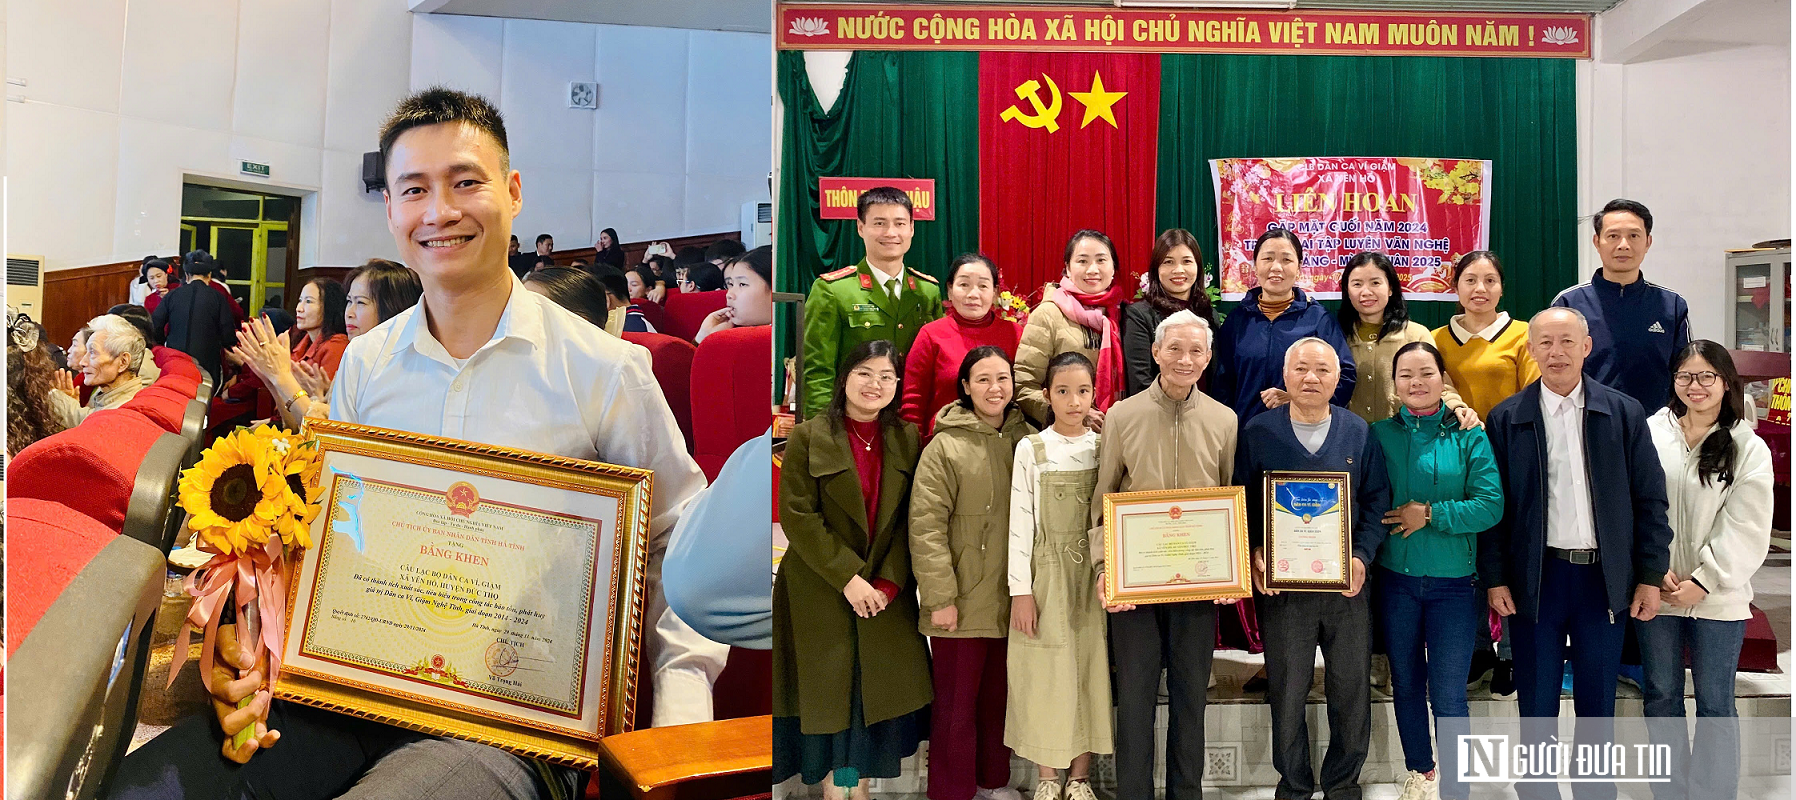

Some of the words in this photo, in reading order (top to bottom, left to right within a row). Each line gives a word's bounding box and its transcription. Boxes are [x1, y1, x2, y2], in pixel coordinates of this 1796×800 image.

[838, 11, 905, 40] NƯỚC
[912, 13, 980, 44] CỘNG
[988, 12, 1037, 41] HÒA
[1044, 13, 1077, 41] XÃ
[1085, 15, 1124, 46] HỘI
[1132, 13, 1180, 42] CHỦ
[1188, 17, 1261, 44] NGHĨA
[1268, 17, 1317, 48] VIỆT
[1326, 22, 1380, 45] NAM
[1388, 19, 1459, 46] MUÔN
[1465, 20, 1520, 46] NĂM
[246, 163, 265, 171] EXIT
[1341, 162, 1355, 170] CA
[824, 186, 857, 207] THÔN
[1275, 187, 1337, 213] LIÊN
[1344, 192, 1417, 213] HOAN
[1299, 219, 1325, 235] MẶT
[1365, 219, 1395, 232] NĂM
[1397, 222, 1428, 233] 2024
[1318, 237, 1341, 252] TẬP
[1344, 237, 1381, 252] LUYỆN
[1386, 236, 1410, 249] VĂN
[1414, 238, 1450, 254] NGHỆ
[1302, 253, 1330, 266] ẢNG
[1412, 257, 1441, 267] 2025
[391, 520, 405, 529] CHỦ
[406, 522, 421, 532] TỊCH
[432, 527, 445, 536] BAN
[446, 530, 464, 539] NHÂN
[465, 534, 479, 542] DÂN
[455, 551, 490, 567] KHEN
[416, 567, 431, 577] LẠC
[442, 570, 458, 581] DÂN
[400, 573, 410, 582] XÃ
[411, 574, 425, 585] YÊN
[440, 581, 465, 594] HUYỆN
[466, 587, 481, 597] ĐỨC
[483, 592, 499, 601] THỌ
[384, 589, 397, 598] Dân
[493, 612, 509, 621] 2014
[513, 617, 529, 626] 2024
[451, 594, 468, 604] trong
[468, 597, 483, 607] công
